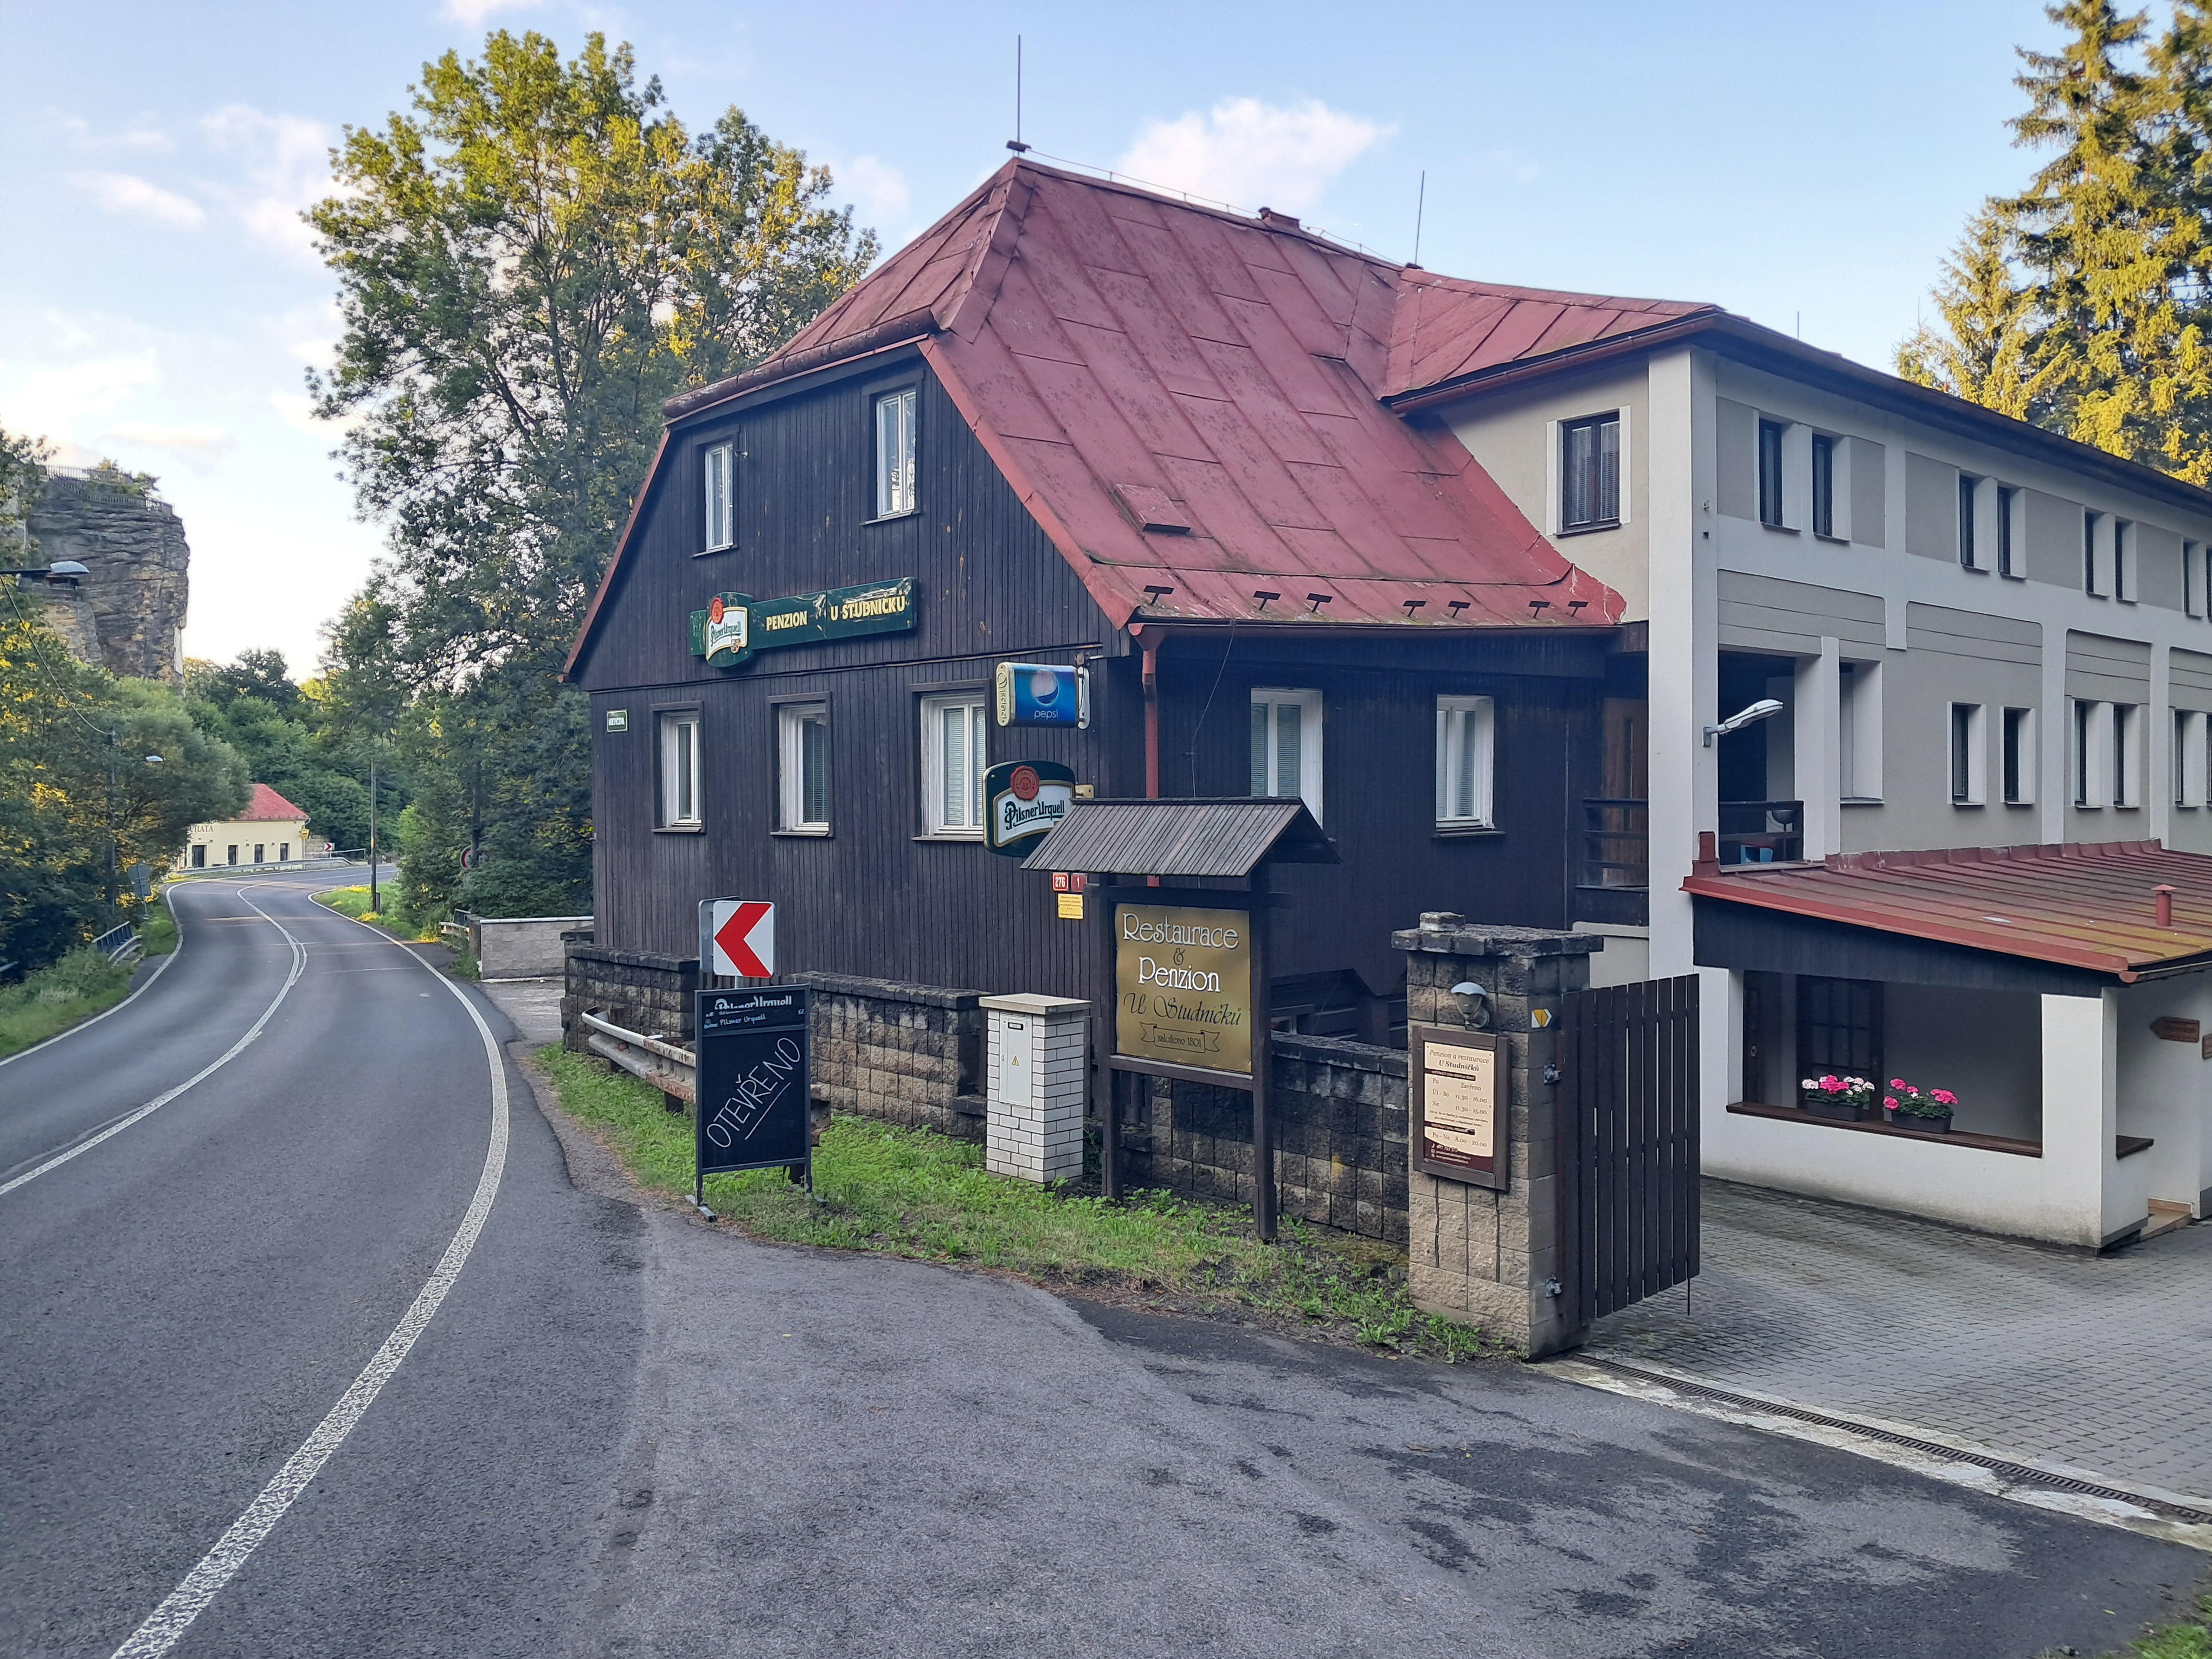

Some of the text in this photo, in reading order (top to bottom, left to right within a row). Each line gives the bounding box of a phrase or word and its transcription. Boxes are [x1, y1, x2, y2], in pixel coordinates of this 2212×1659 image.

[766, 590, 905, 631] PENZION U STUDNIČKŮ
[1034, 708, 1059, 720] pepsi
[1005, 800, 1065, 830] Pilsner Urquell
[1054, 876, 1065, 888] 276
[1077, 877, 1080, 888] 1
[1122, 912, 1239, 949] Restaurace
[1173, 947, 1185, 965] &
[1138, 956, 1220, 992] Penzion
[1123, 993, 1242, 1026] U Studničků
[1157, 1033, 1202, 1048] založeno 1801
[1430, 1049, 1451, 1059] Penzion
[1458, 1054, 1489, 1064] restaurace
[1445, 1060, 1480, 1072] Studničků
[707, 1038, 800, 1148] OTEVŘENO
